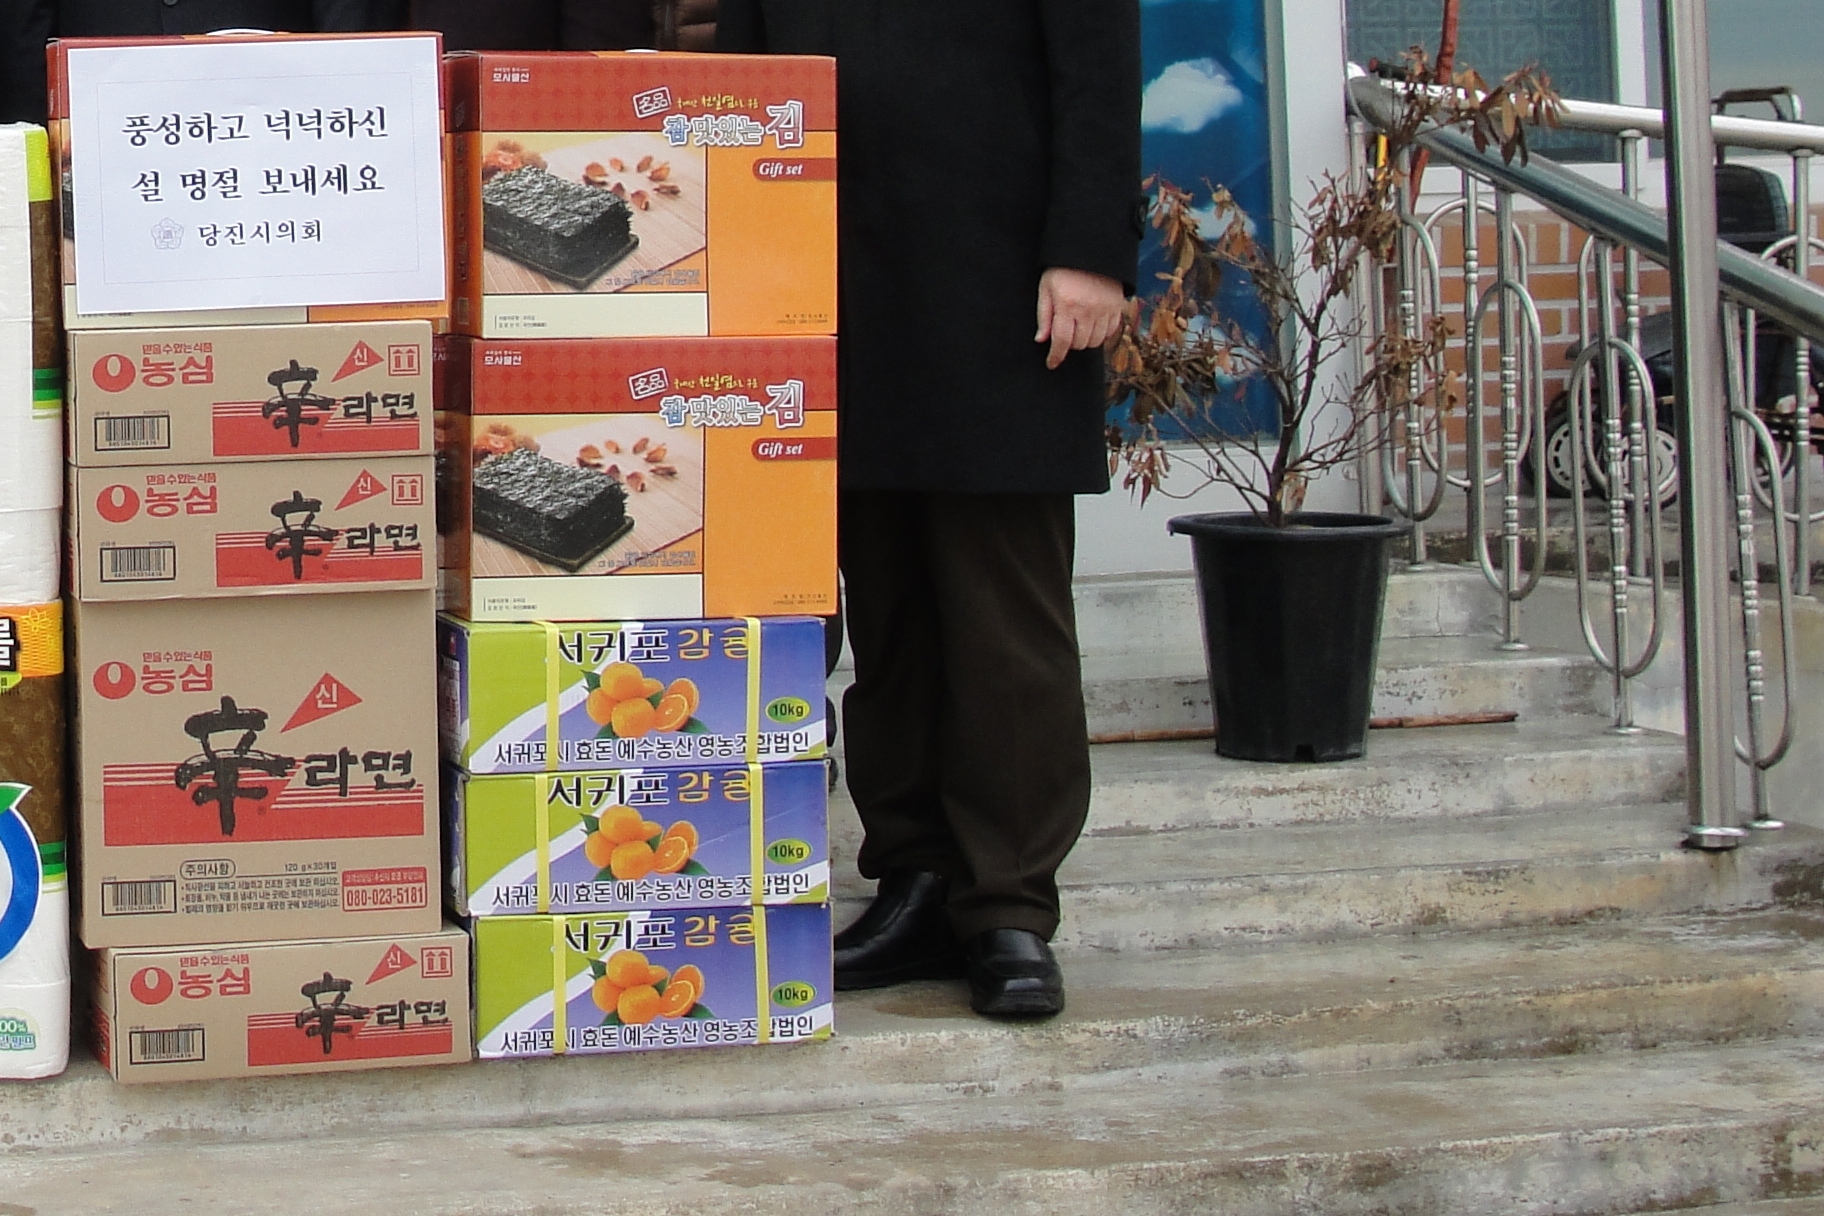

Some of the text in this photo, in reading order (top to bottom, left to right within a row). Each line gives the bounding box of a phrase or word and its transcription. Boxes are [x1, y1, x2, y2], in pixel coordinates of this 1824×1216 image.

[121, 105, 389, 147] 풍성하고 넉넉하신
[663, 100, 804, 149] 참 맛있는 김
[131, 163, 385, 202] 설 명절 보내세요
[759, 162, 803, 178] Gift set
[197, 219, 323, 247] 당진시의회
[353, 346, 369, 367] 신
[140, 354, 215, 388] 농심
[660, 380, 804, 429] 참 맛있는 김
[758, 442, 804, 457] Gift set
[357, 477, 372, 495] 신
[144, 485, 219, 518] 농심
[558, 627, 750, 664] 서귀포 감귤
[140, 663, 214, 695] 농심
[315, 683, 338, 709] 신
[771, 702, 804, 718] 10kg
[574, 738, 614, 762] 효돈
[617, 735, 694, 761] 예수농산
[547, 770, 752, 807] 서귀포 감귤
[772, 844, 805, 859] 10kg
[184, 862, 230, 877] 주의사항
[346, 885, 424, 908] 080-023-5181
[574, 879, 612, 904] 효돈
[616, 877, 694, 903] 예수농산
[564, 913, 757, 952] 서귀포 감귤
[386, 950, 402, 967] 신
[177, 967, 252, 999] 농심
[776, 986, 810, 1002] 10kg
[581, 1025, 619, 1049] 효돈
[622, 1022, 700, 1047] 예수농산
